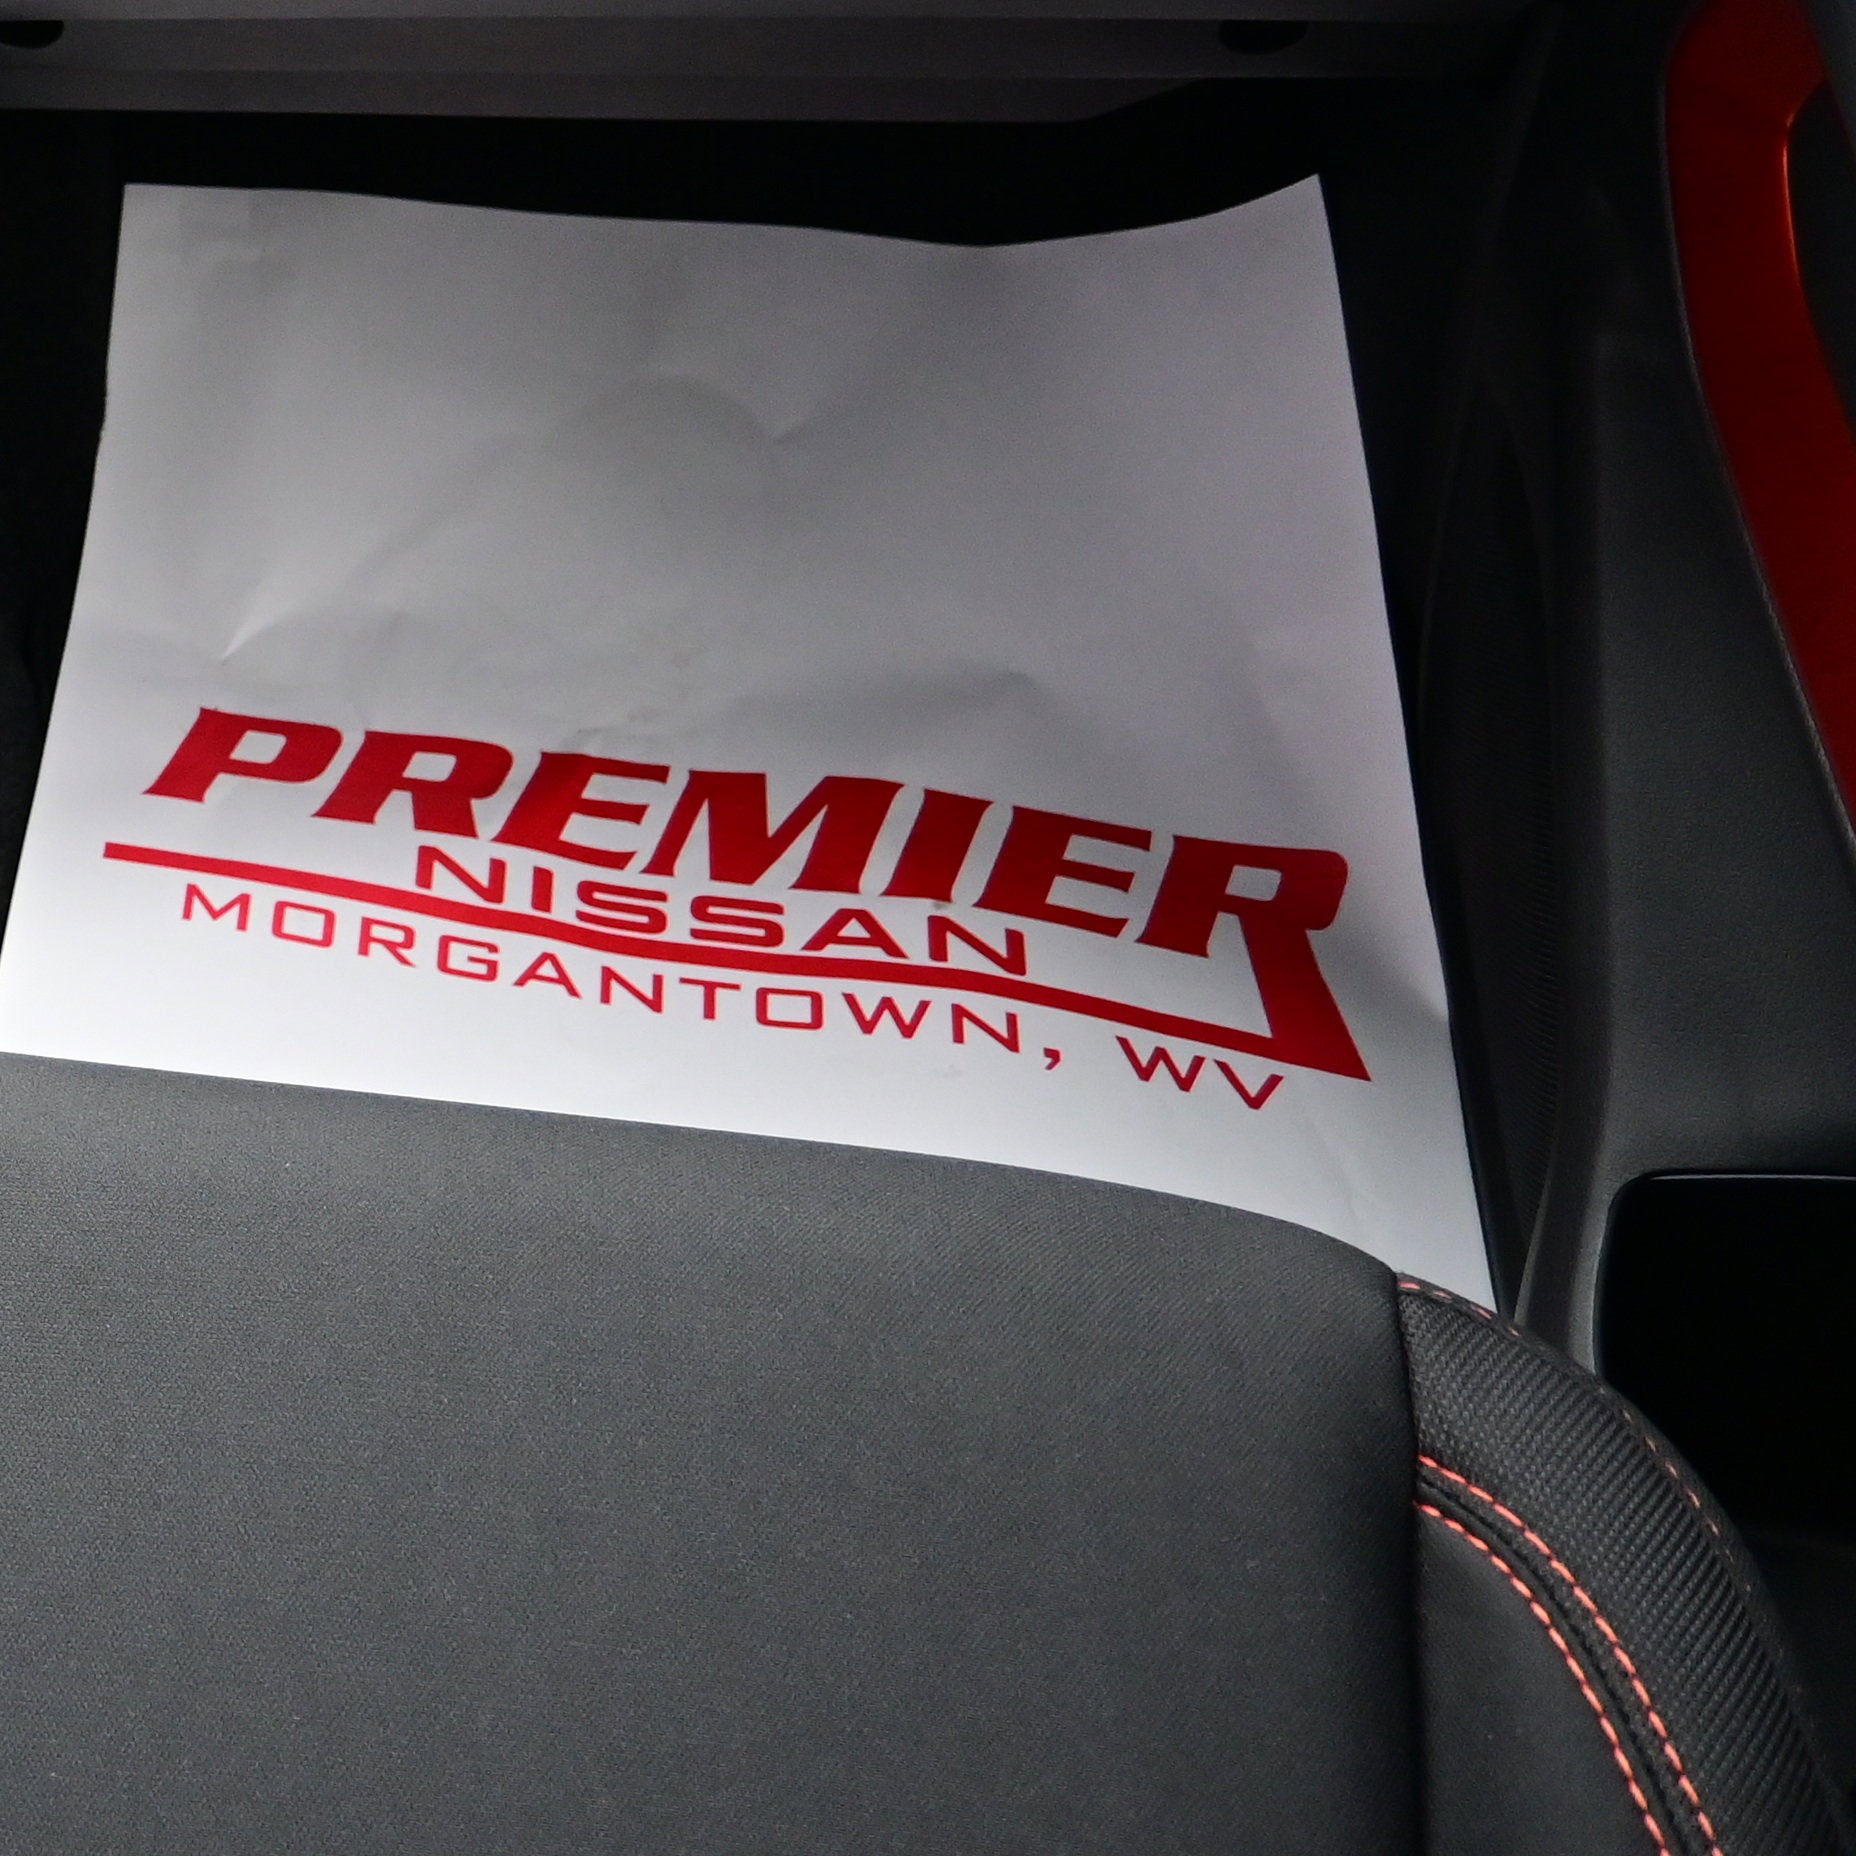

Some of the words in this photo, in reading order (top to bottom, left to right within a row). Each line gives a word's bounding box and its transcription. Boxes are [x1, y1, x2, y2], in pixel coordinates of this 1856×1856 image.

[143, 705, 1371, 1083] PREMIER
[181, 882, 1063, 1069] MORGANTOWN,
[1115, 1034, 1285, 1110] WV
[412, 846, 1029, 977] NISSAN
